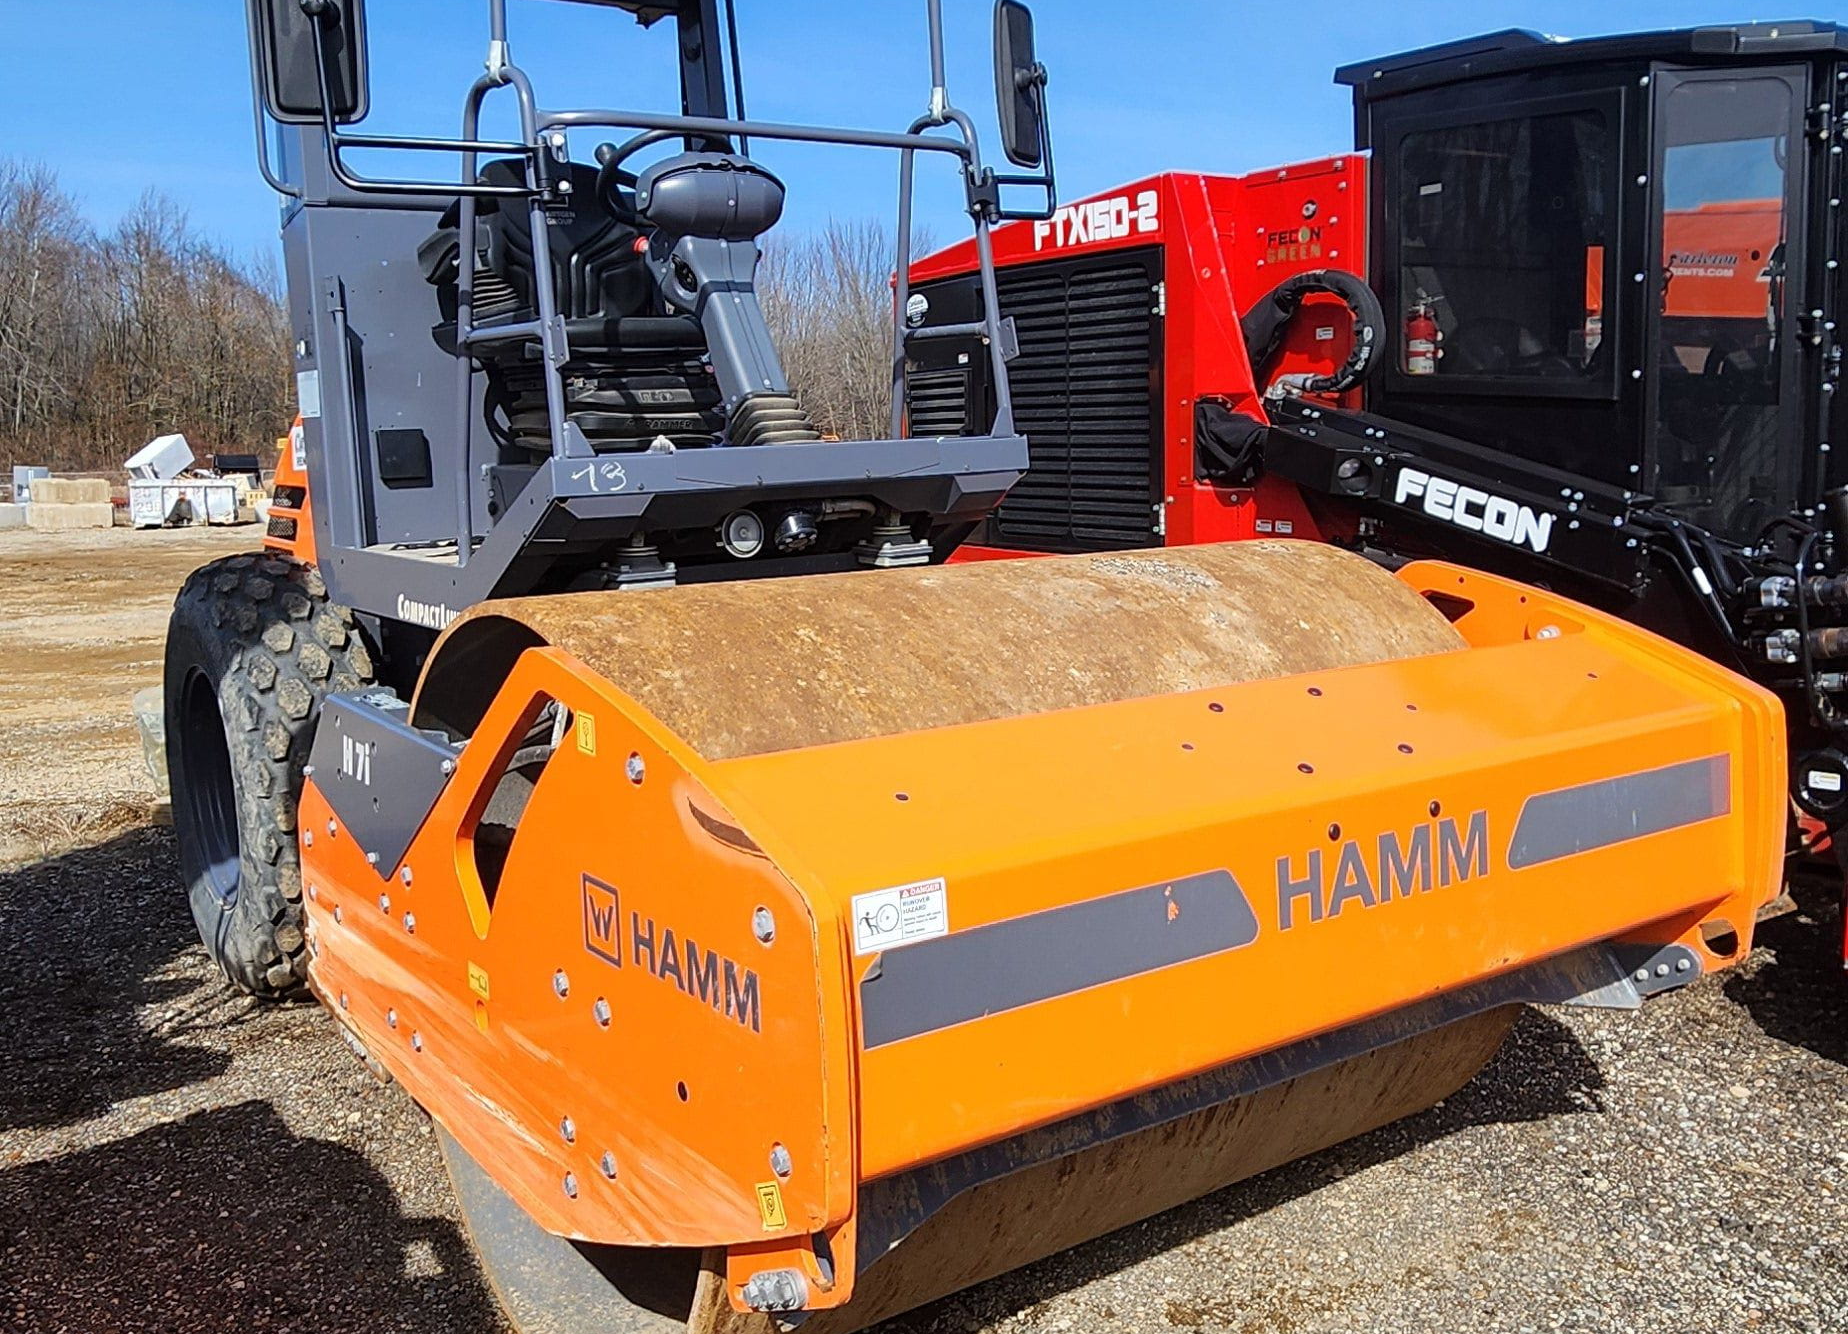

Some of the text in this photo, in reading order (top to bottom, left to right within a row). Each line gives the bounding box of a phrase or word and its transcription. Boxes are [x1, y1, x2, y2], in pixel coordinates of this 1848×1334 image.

[1034, 190, 1159, 252] FTX150-2
[1267, 226, 1322, 247] FECON
[1395, 467, 1552, 552] FECON
[343, 734, 353, 776] H
[909, 882, 940, 896] DANGER
[1276, 810, 1489, 931] HAMM
[632, 911, 760, 1034] HAMM
